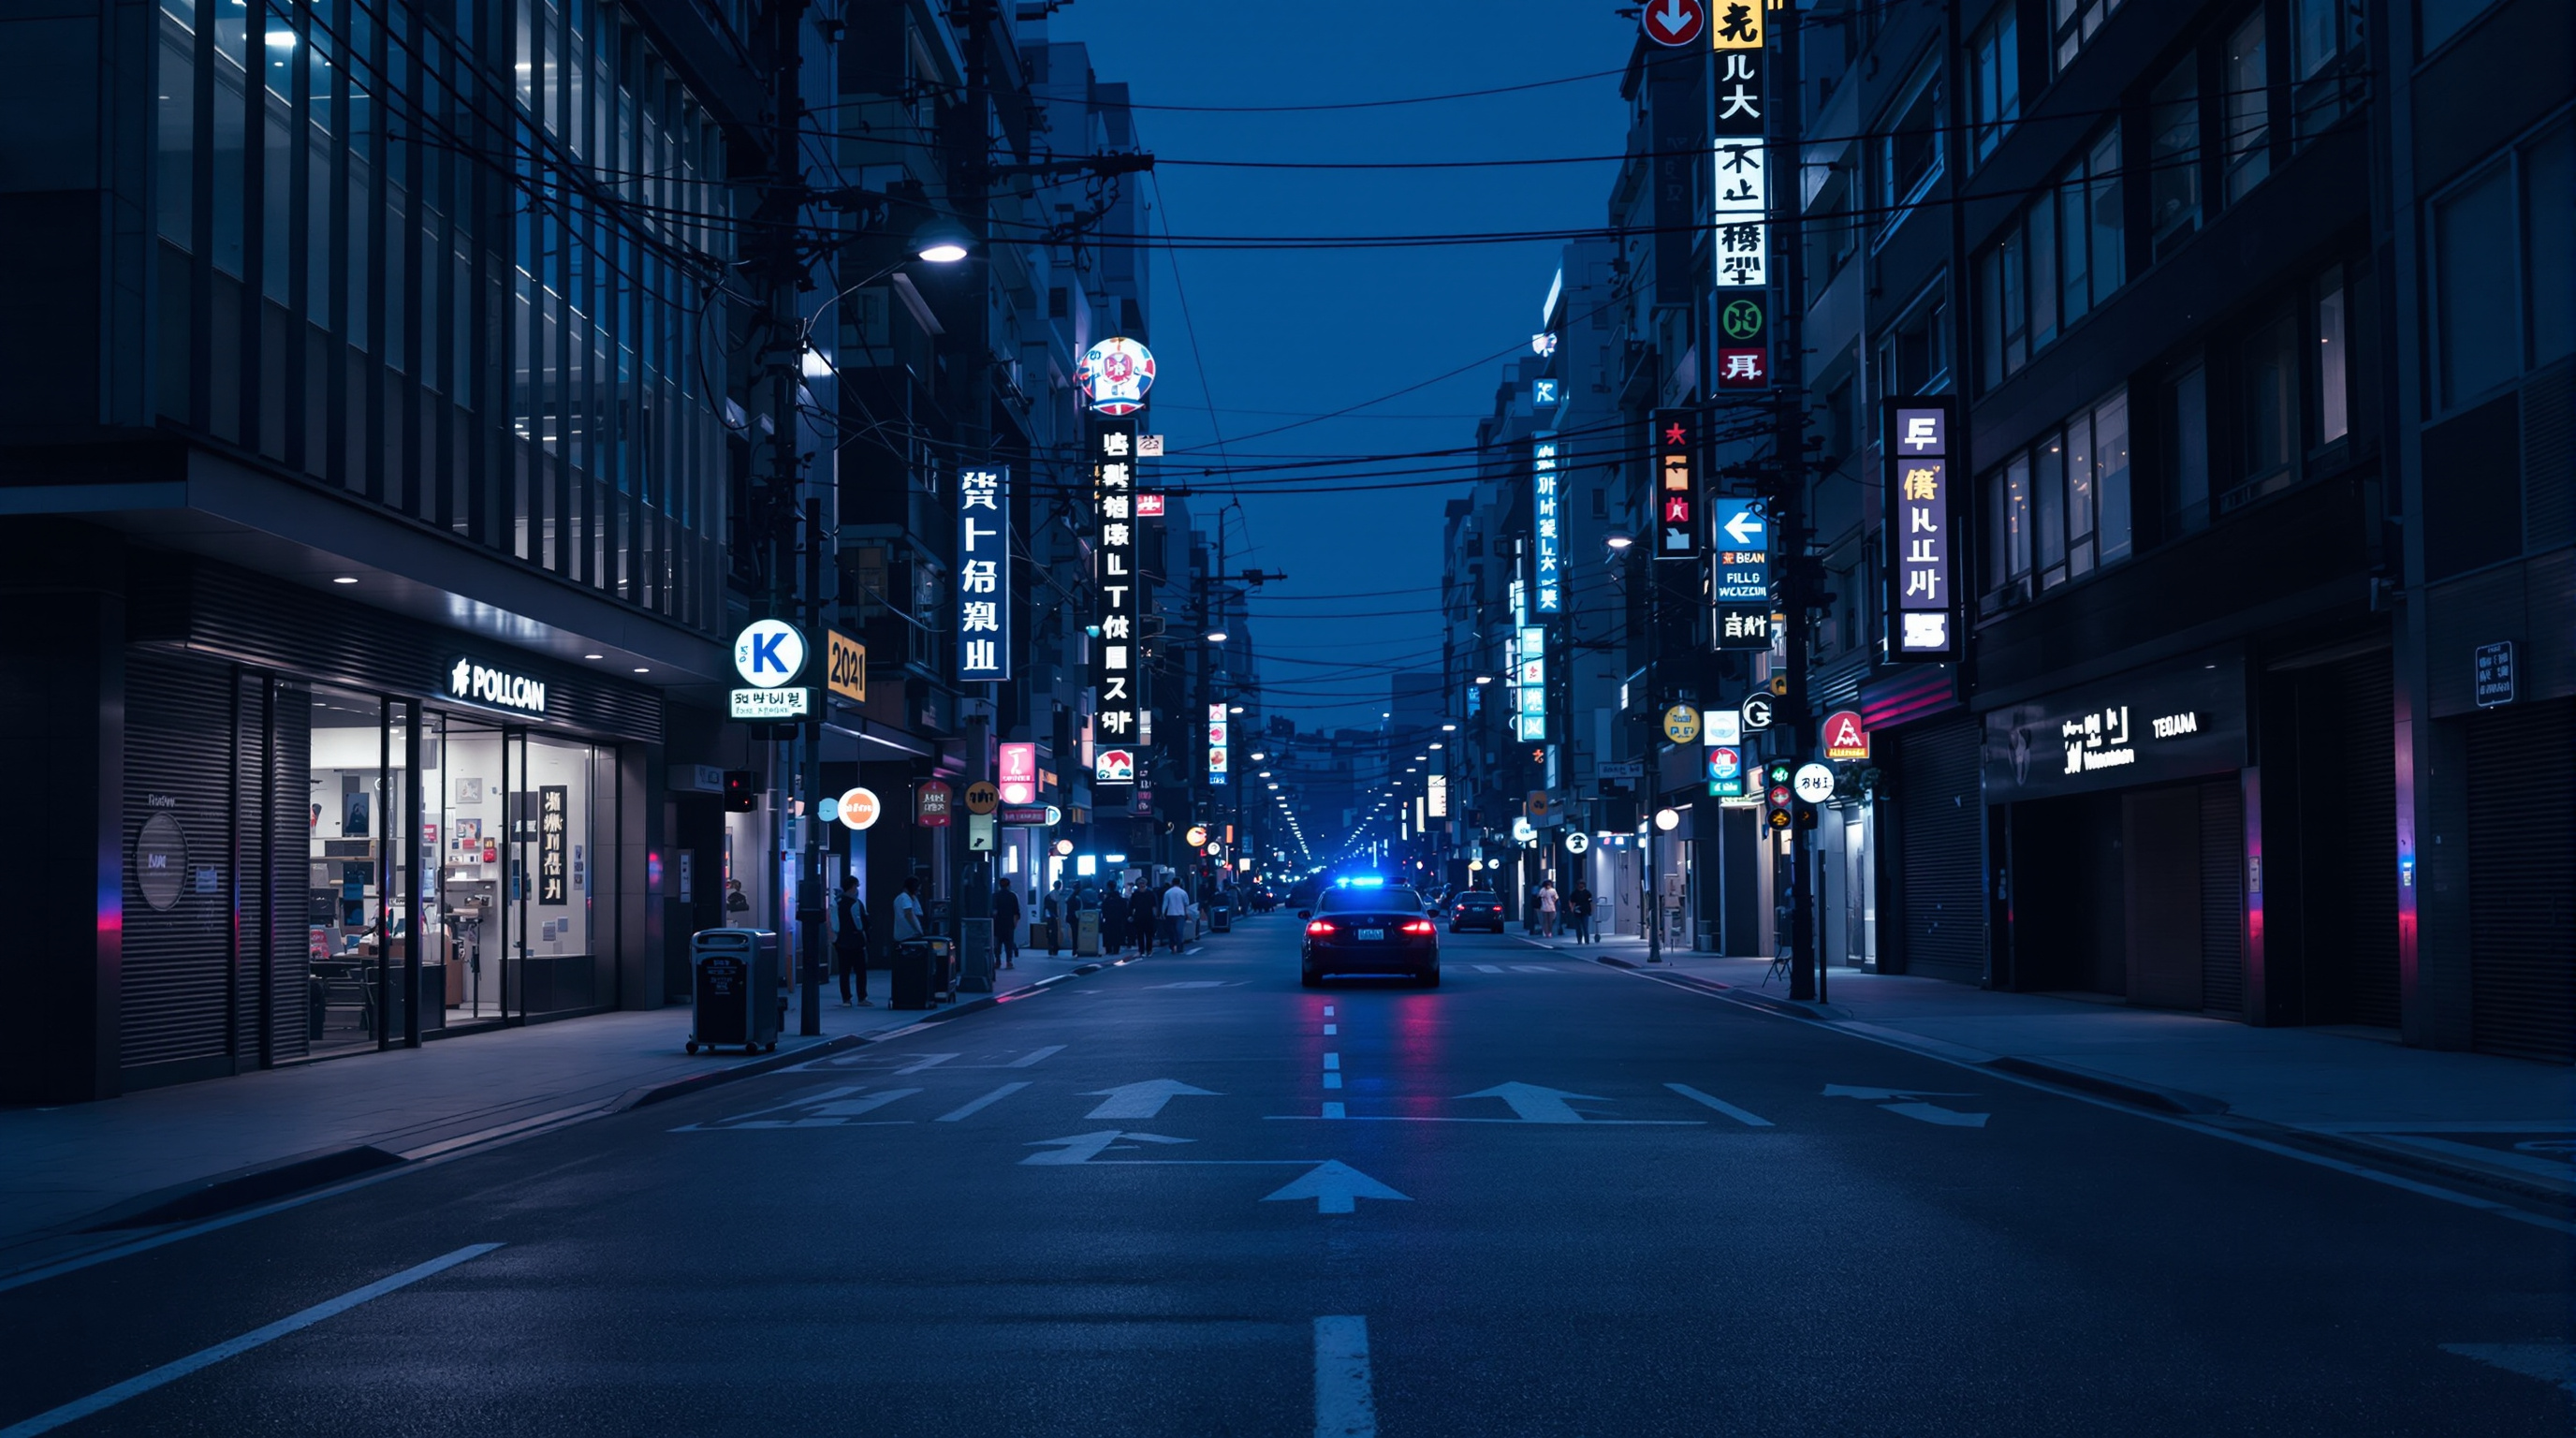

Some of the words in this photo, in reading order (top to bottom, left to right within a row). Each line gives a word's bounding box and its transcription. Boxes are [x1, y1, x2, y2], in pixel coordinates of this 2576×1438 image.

[753, 633, 789, 673] K
[831, 641, 863, 691] 2021
[473, 665, 545, 712] POLLCAN
